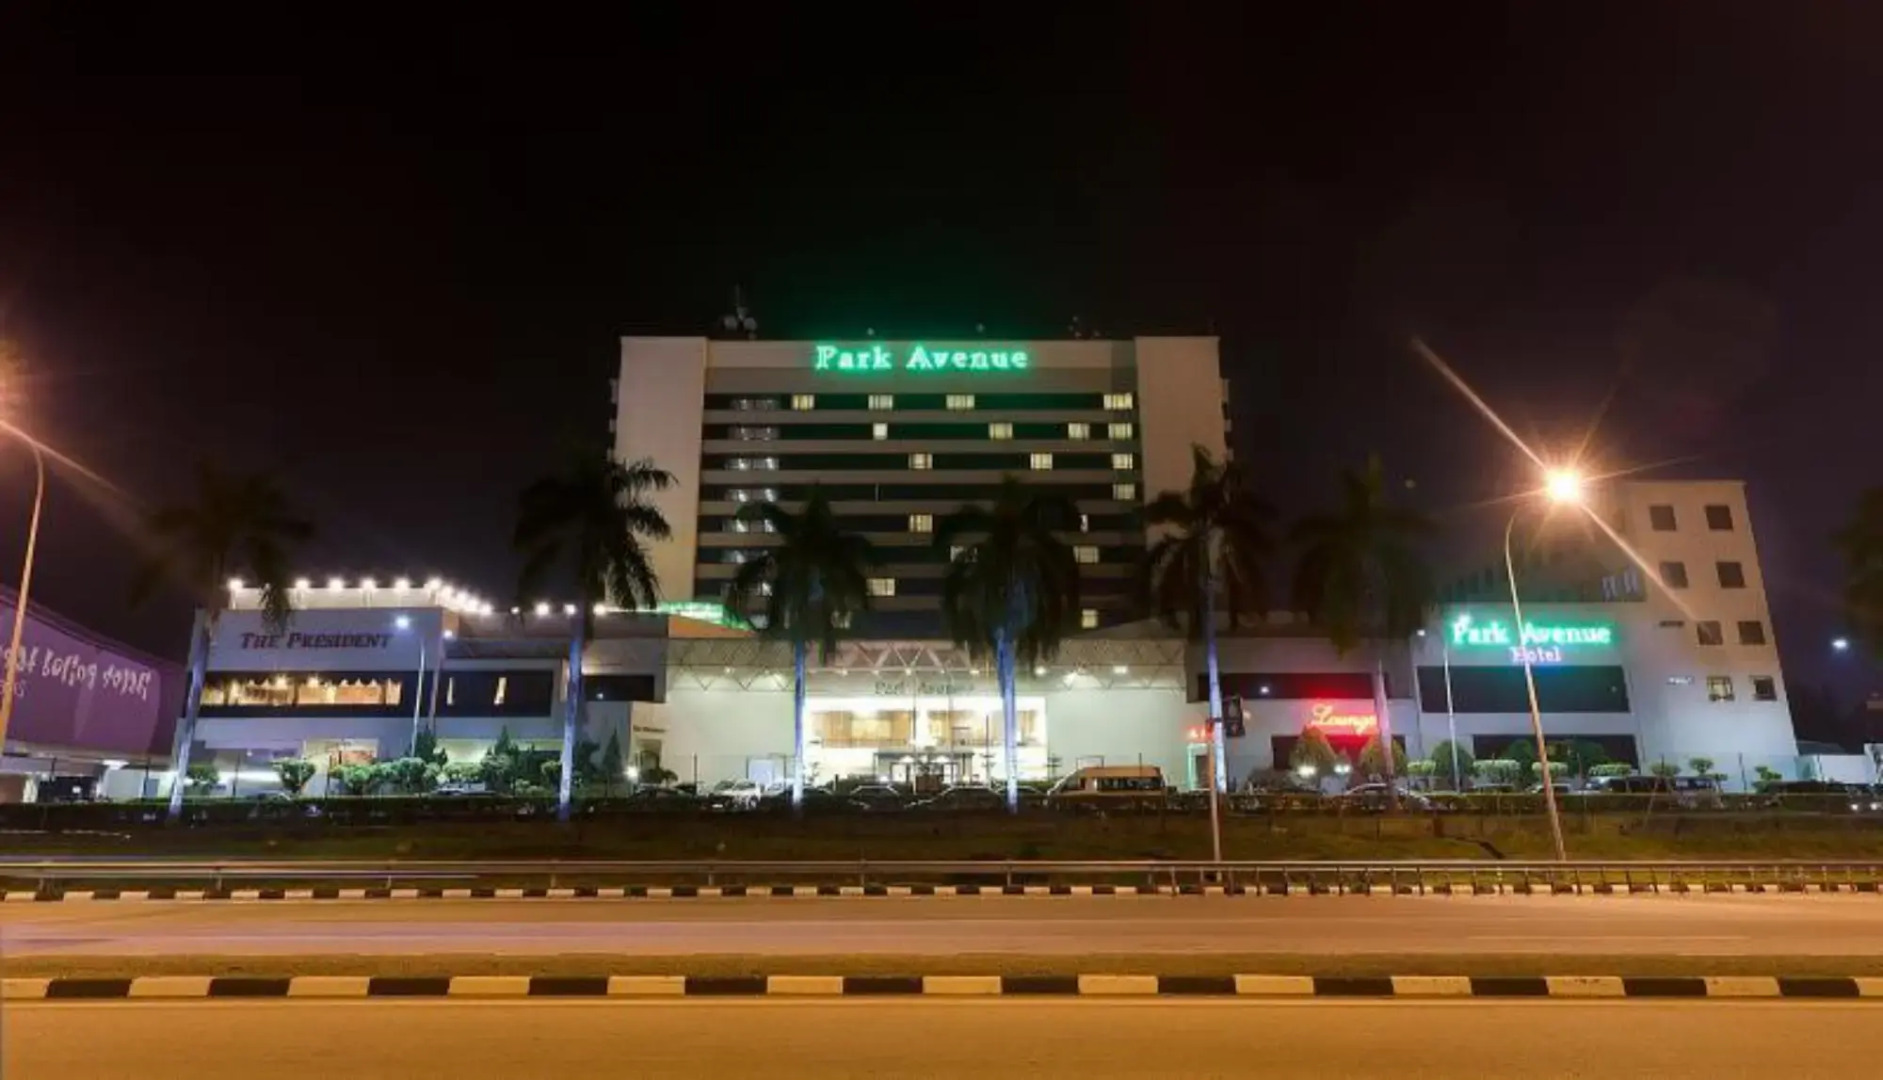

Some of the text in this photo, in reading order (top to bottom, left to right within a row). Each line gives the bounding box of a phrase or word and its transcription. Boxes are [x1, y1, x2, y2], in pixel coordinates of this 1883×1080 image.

[815, 344, 1028, 370] Park Avenue
[240, 632, 394, 649] THE PRESIDENT
[1453, 619, 1612, 644] Park Avenue
[1510, 646, 1562, 663] Hotel
